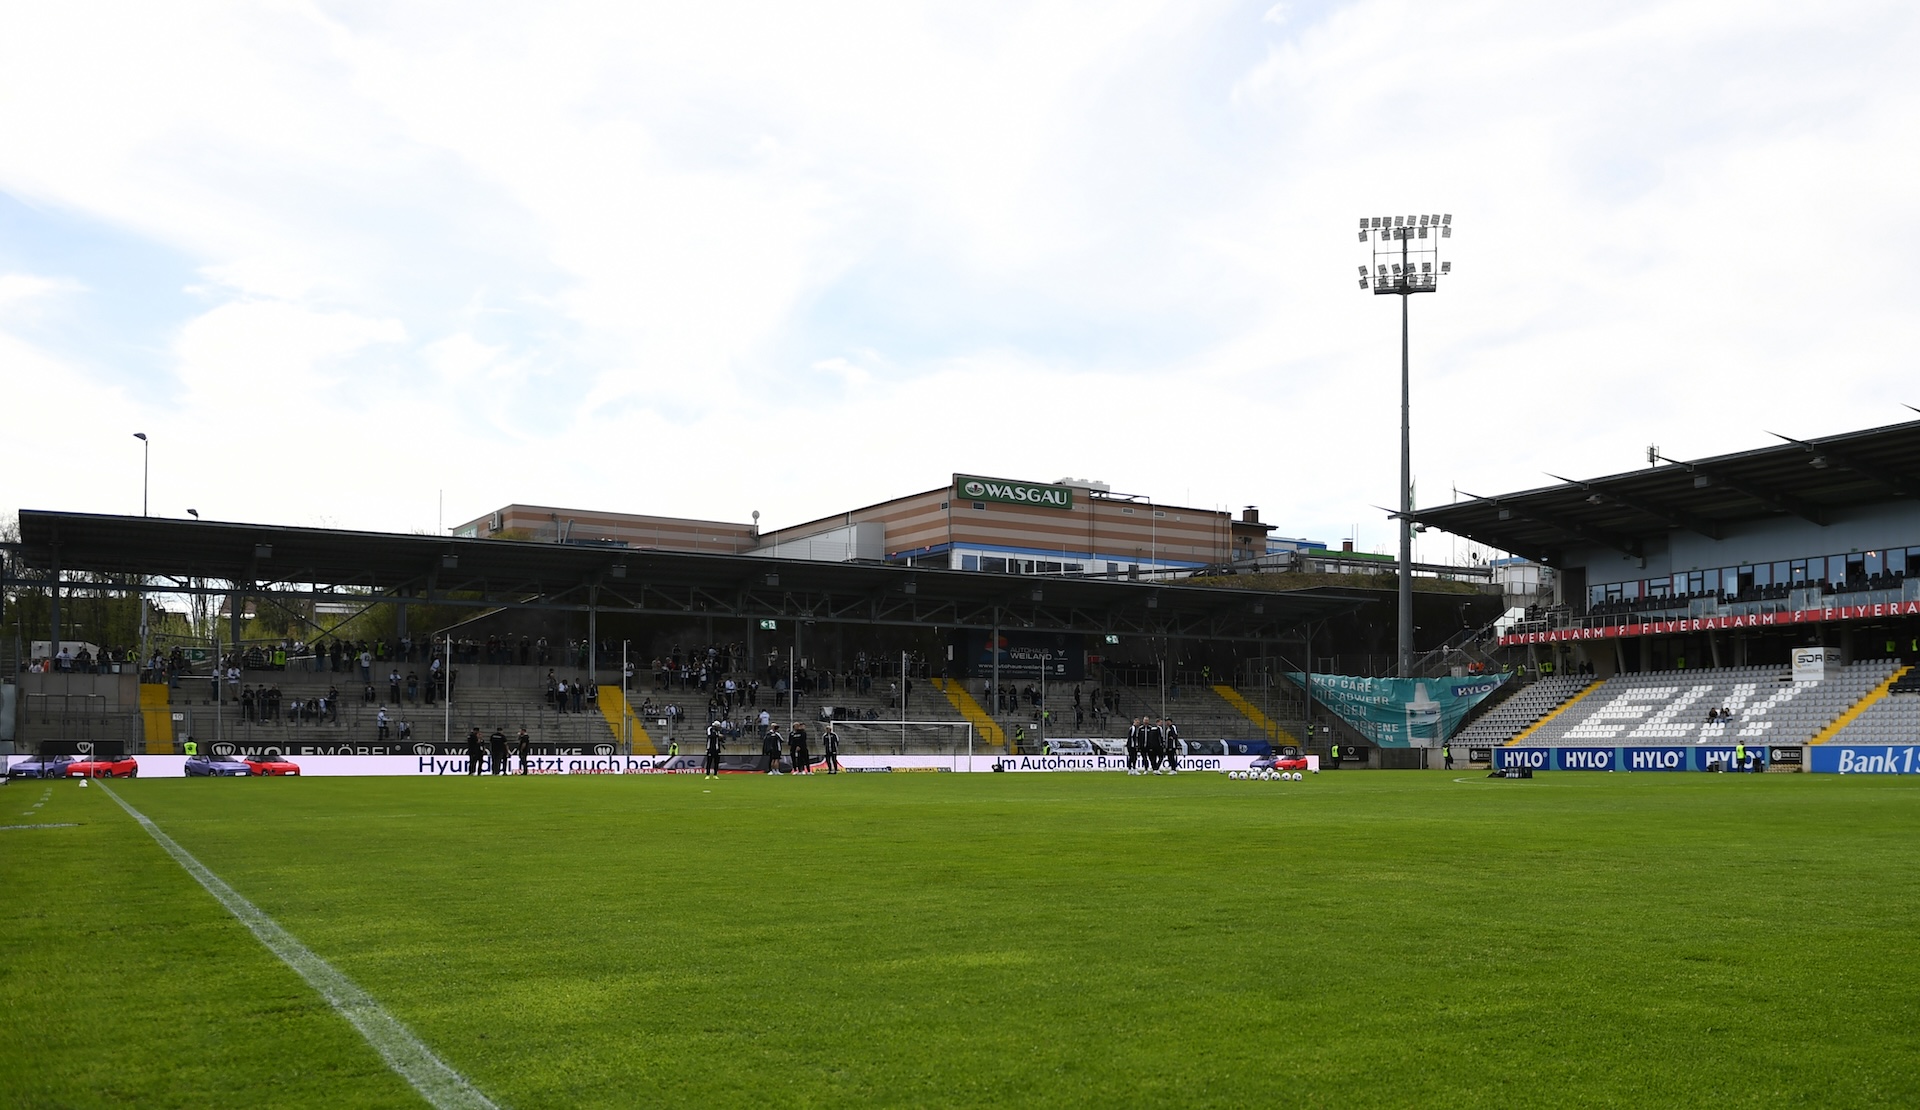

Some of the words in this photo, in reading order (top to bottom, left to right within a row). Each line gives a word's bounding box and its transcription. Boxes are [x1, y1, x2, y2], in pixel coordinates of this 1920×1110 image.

[984, 483, 1067, 505] WASGAU
[1642, 612, 1774, 635] FLYERALARM
[1499, 627, 1604, 646] FLYERALARM
[1010, 652, 1052, 660] WEILAND
[1339, 692, 1389, 705] ABWEHR
[569, 756, 620, 770] auch
[626, 755, 656, 769] bei
[997, 756, 1017, 769] Im
[1021, 756, 1094, 770] Autohaus
